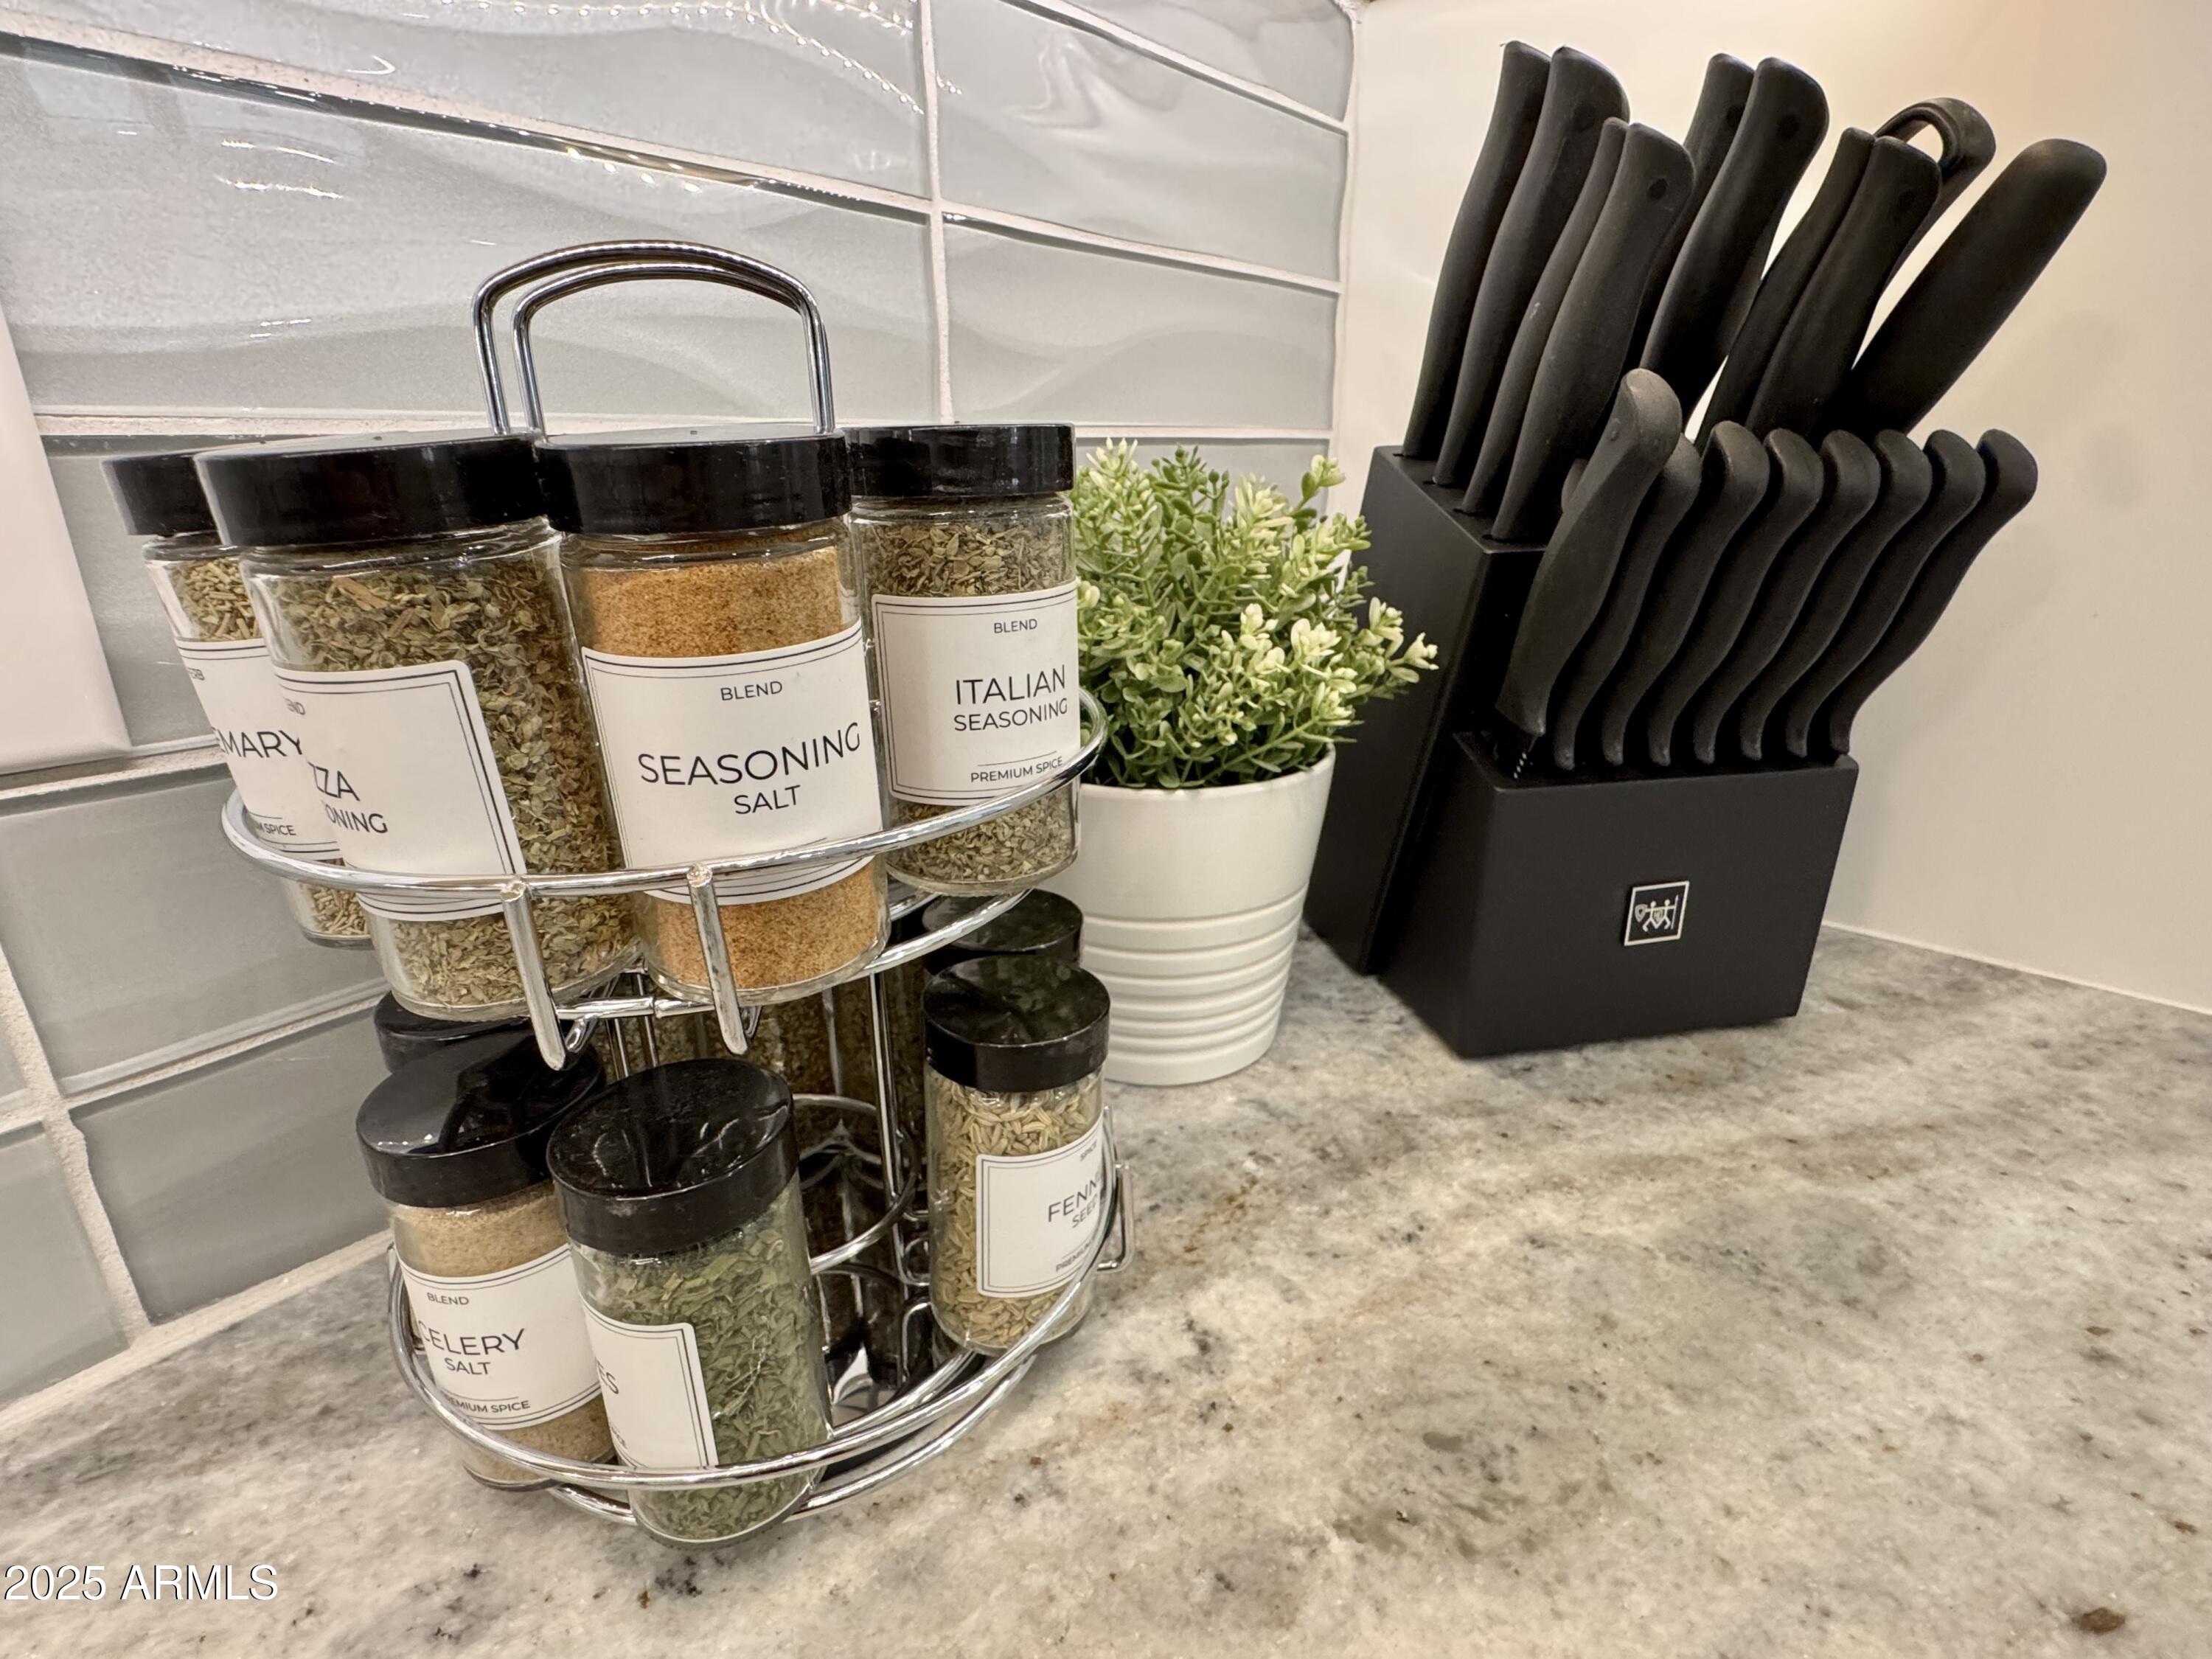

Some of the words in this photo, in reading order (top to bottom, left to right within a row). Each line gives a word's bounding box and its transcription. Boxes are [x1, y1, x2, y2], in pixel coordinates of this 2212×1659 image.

[993, 618, 1038, 634] BLEND
[720, 681, 784, 701] BLEND
[955, 664, 1066, 706] ITALIAN
[953, 698, 1068, 732] SEASONING
[211, 726, 303, 759] MARY
[638, 722, 861, 786] SEASONING
[970, 765, 1033, 783] PREMIUM
[1035, 756, 1063, 774] SPICE
[734, 785, 801, 815] SALT
[262, 824, 297, 837] SPICE
[321, 799, 389, 834] ONING
[1048, 1179, 1097, 1222] FENN
[426, 1292, 470, 1306] BLEND
[417, 1320, 525, 1356] CELERY
[444, 1357, 491, 1375] SALT
[596, 1359, 619, 1395] ES
[490, 1400, 531, 1413] SPICE
